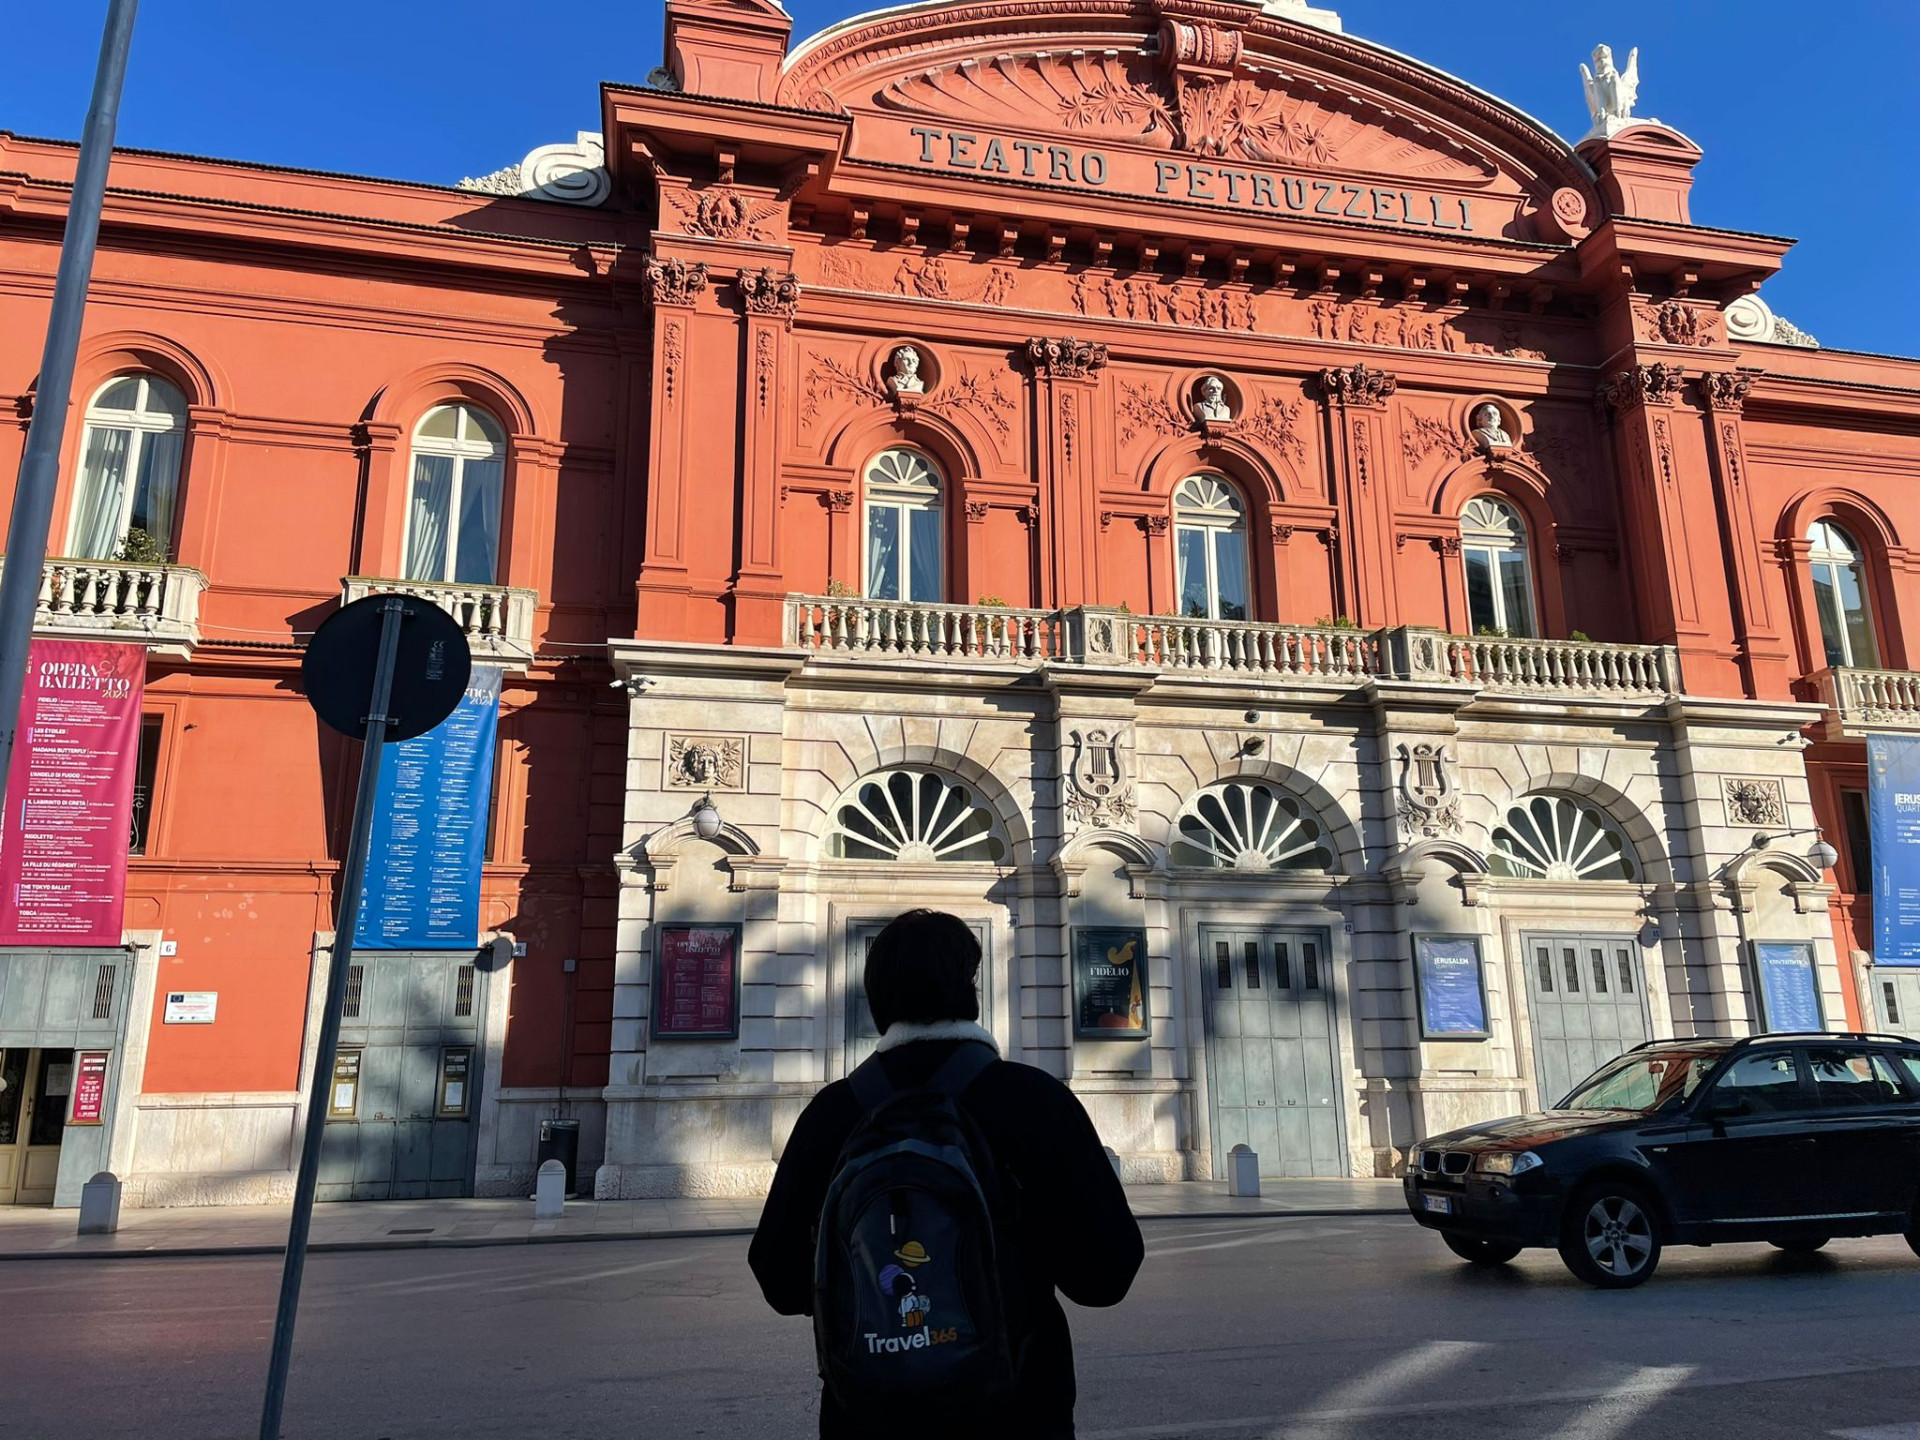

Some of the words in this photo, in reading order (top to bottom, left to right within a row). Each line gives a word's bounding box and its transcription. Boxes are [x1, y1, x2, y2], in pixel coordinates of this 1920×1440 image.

[911, 127, 1108, 185] TEATRO
[1156, 161, 1474, 231] PETRUZZELLI
[41, 662, 98, 677] OPERA
[39, 675, 130, 691] BALLETTO
[102, 689, 128, 698] 2024
[1434, 957, 1469, 965] JERUSALEM
[1090, 967, 1129, 976] FIDELIO
